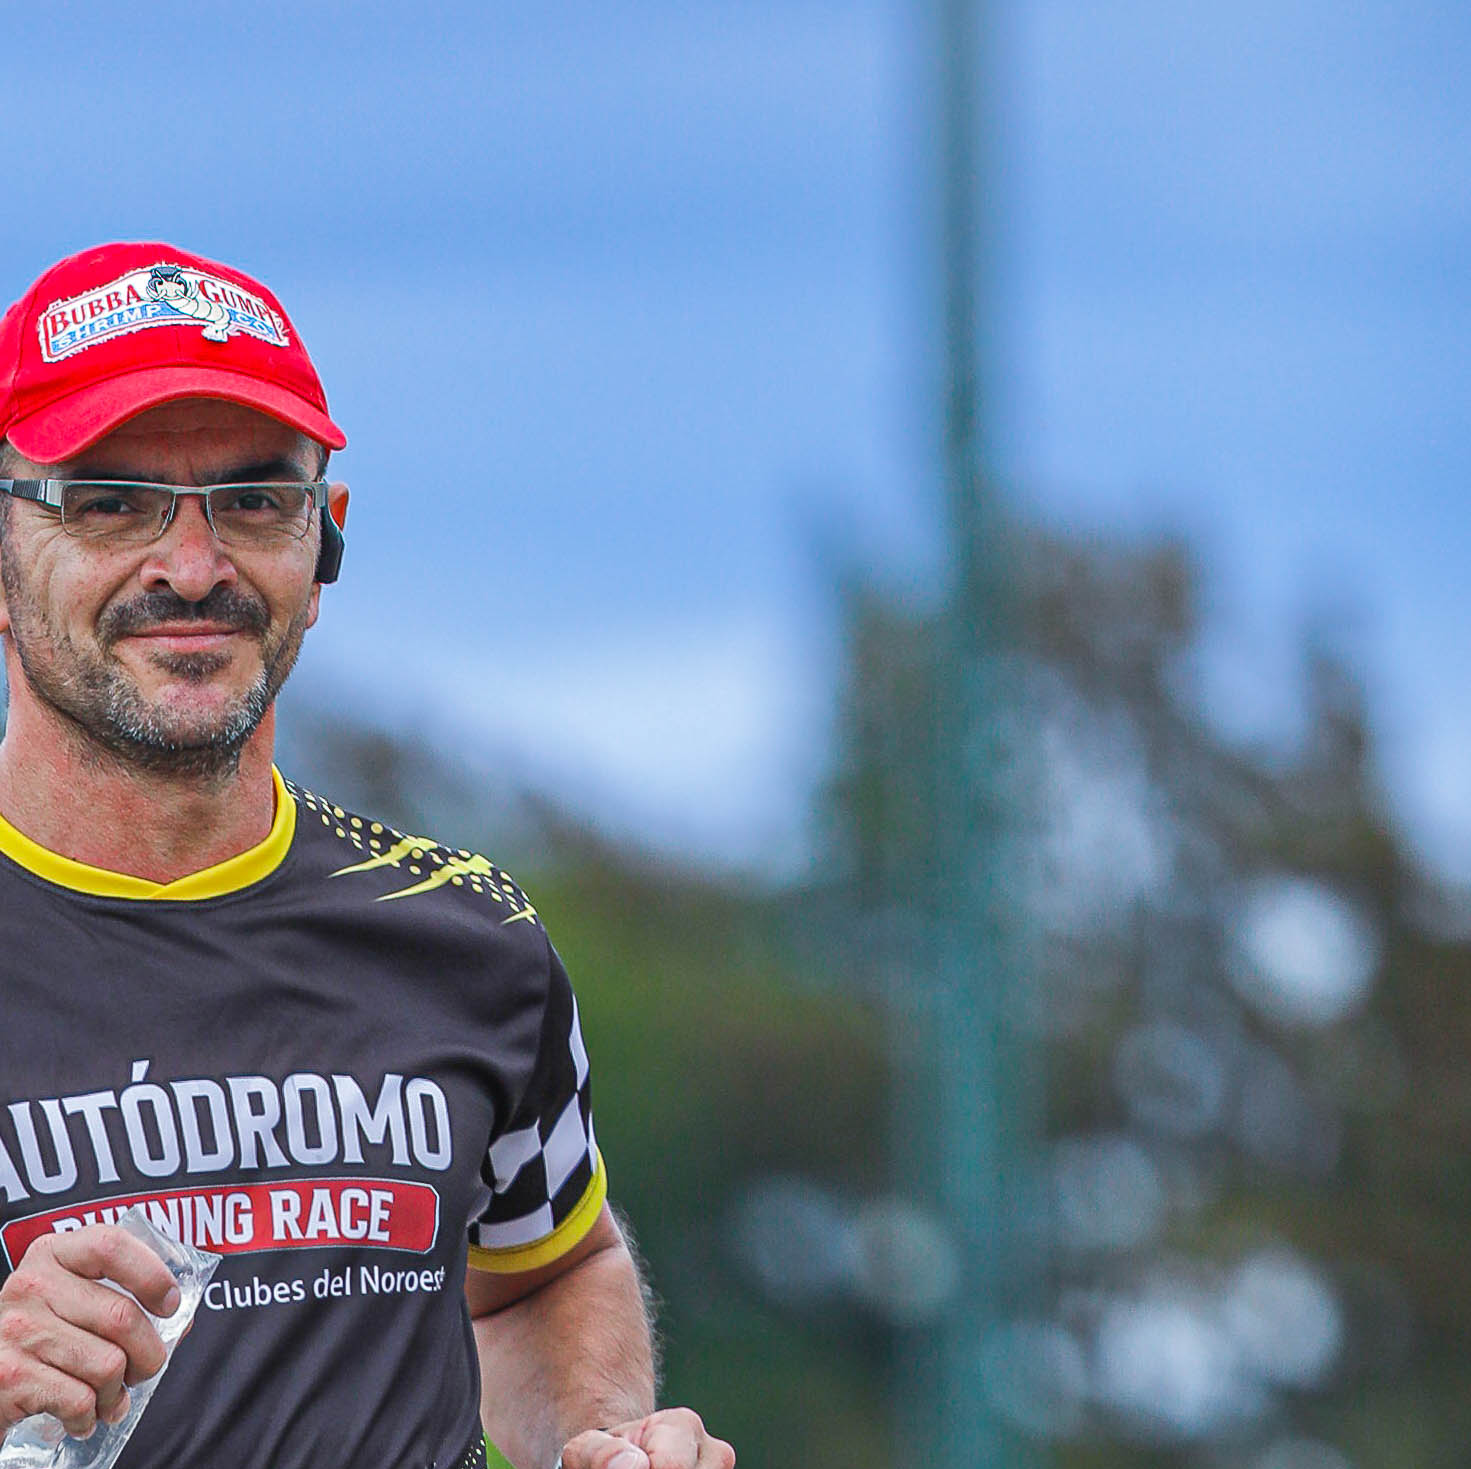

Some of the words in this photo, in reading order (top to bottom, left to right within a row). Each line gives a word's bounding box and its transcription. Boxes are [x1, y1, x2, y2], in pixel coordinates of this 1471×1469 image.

[49, 284, 143, 338] BUBBA
[199, 279, 270, 322] GUMP
[55, 304, 162, 350] SHRIMP
[51, 1191, 255, 1247] NING
[269, 1188, 394, 1243] RACE
[204, 1276, 305, 1310] Clubes
[313, 1266, 352, 1299] del
[360, 1265, 445, 1295] Noroest
